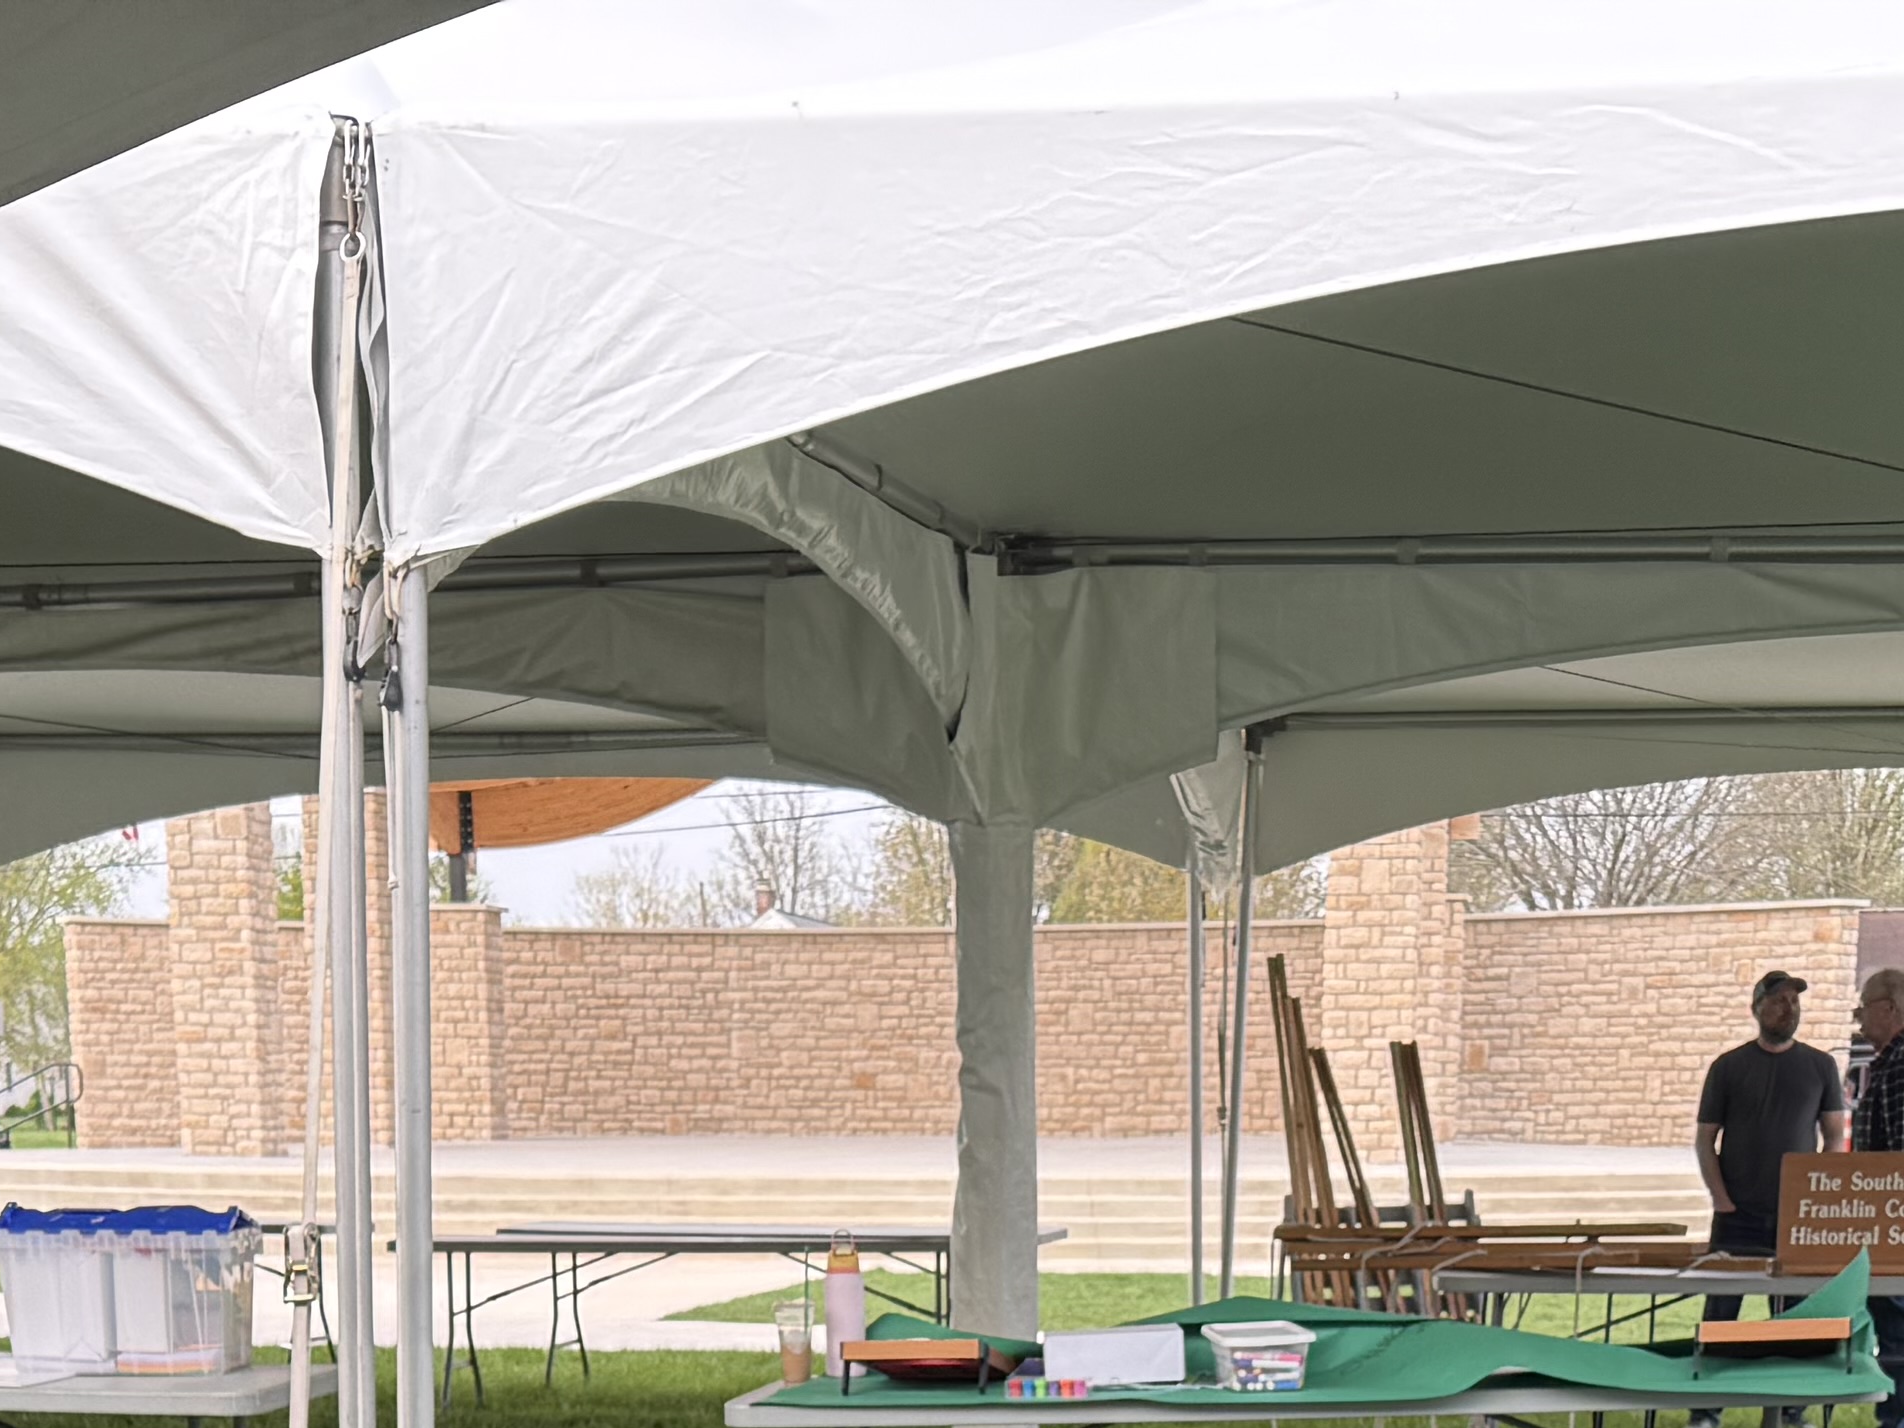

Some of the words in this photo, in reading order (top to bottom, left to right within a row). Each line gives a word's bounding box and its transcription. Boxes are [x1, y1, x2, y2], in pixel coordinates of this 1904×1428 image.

[1808, 1172, 1841, 1192] The
[1799, 1199, 1875, 1218] Franklin
[1790, 1226, 1879, 1245] Historical
